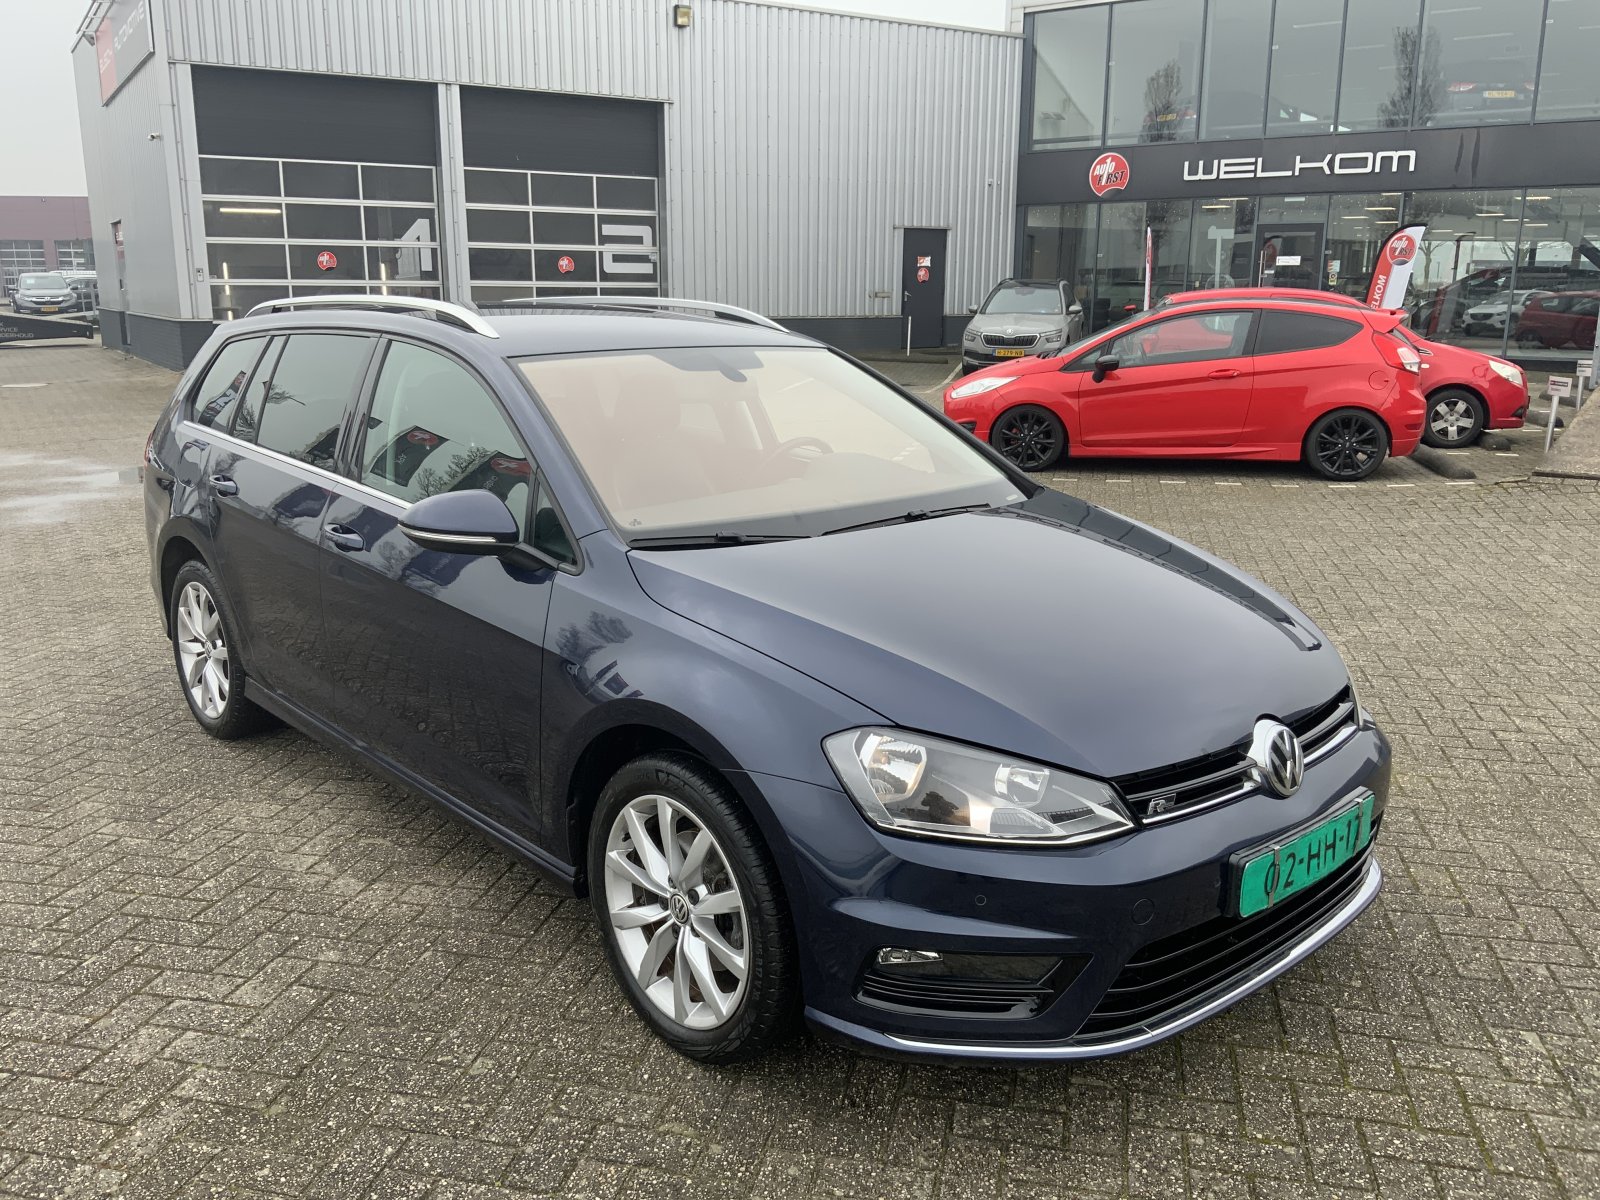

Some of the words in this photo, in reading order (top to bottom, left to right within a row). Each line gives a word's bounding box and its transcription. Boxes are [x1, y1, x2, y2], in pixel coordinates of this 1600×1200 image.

[1183, 150, 1416, 181] WELKOM
[602, 224, 654, 274] 2
[1370, 274, 1387, 309] ELKOM
